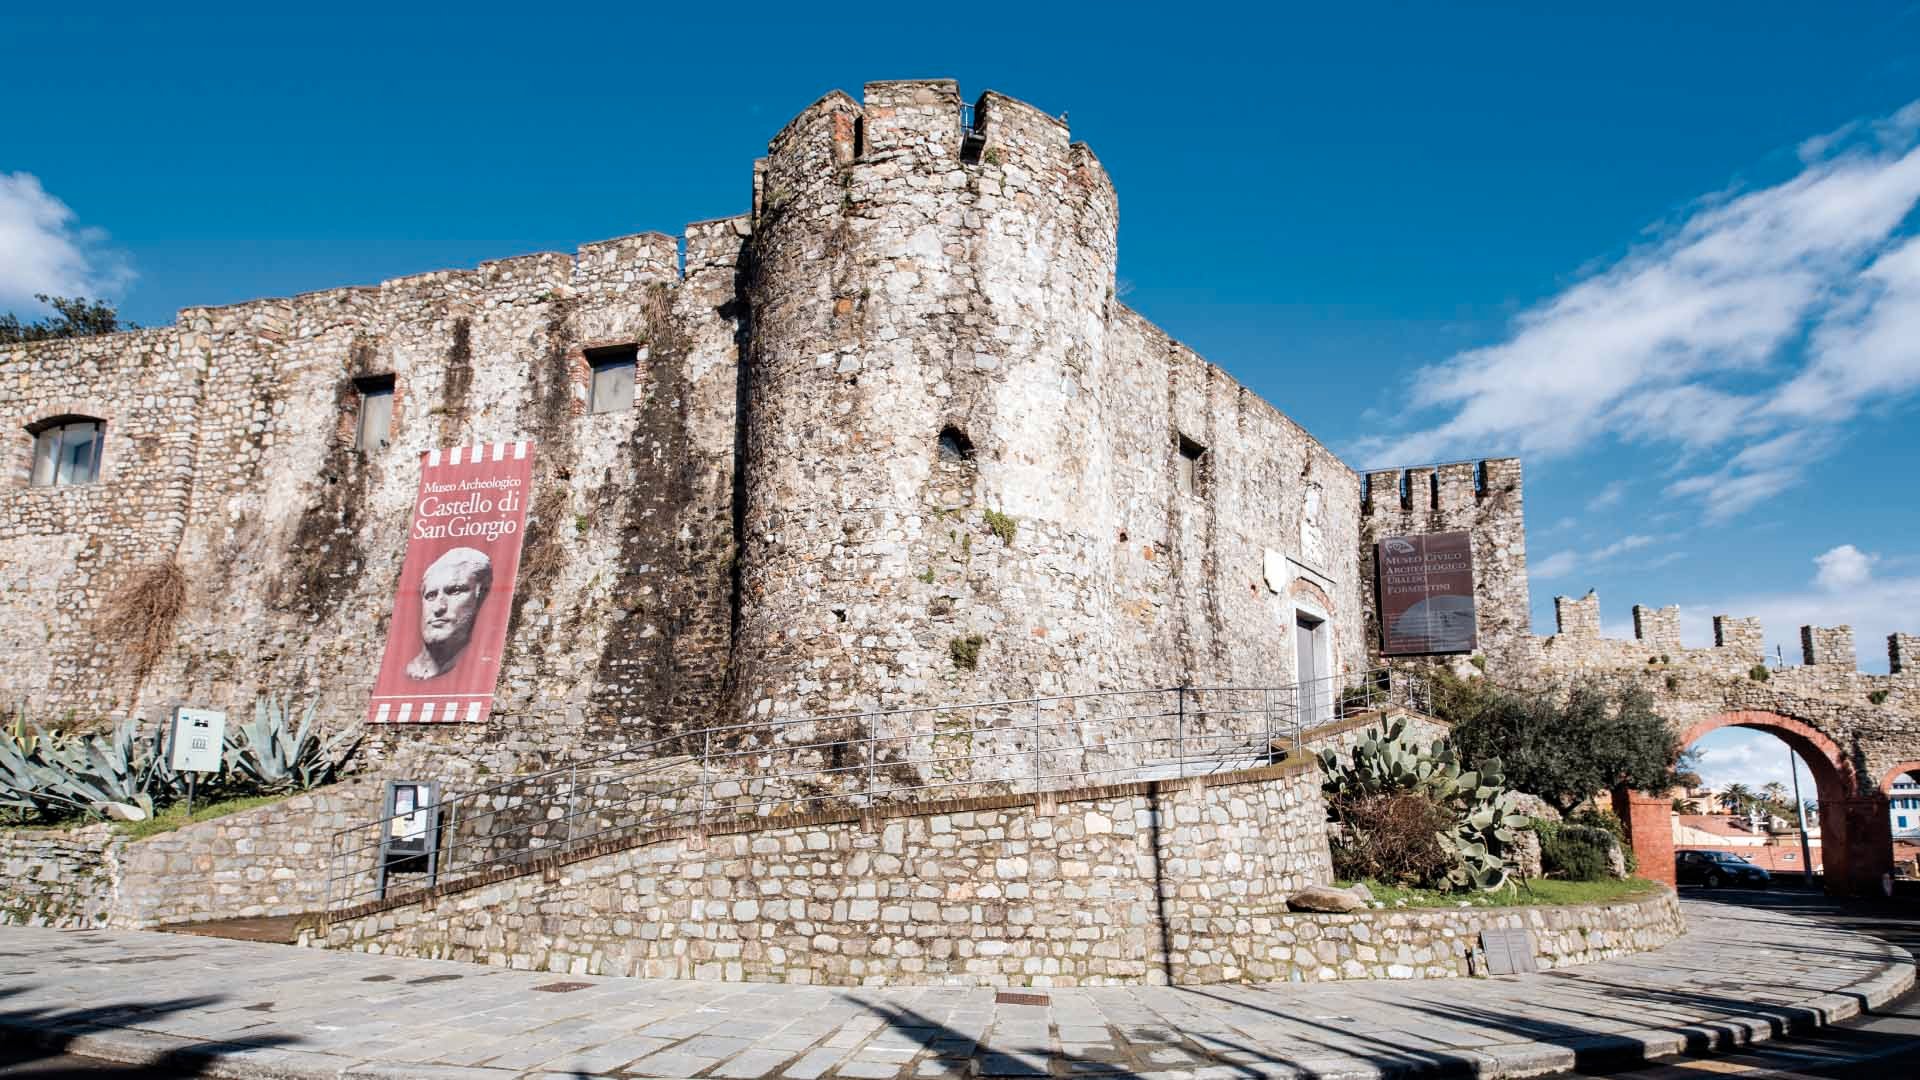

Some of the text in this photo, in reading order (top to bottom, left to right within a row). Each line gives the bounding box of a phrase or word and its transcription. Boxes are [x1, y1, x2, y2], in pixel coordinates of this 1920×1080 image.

[424, 475, 521, 493] Museo Archeologico
[420, 490, 520, 517] Castello di
[413, 513, 517, 541] San Giorgio
